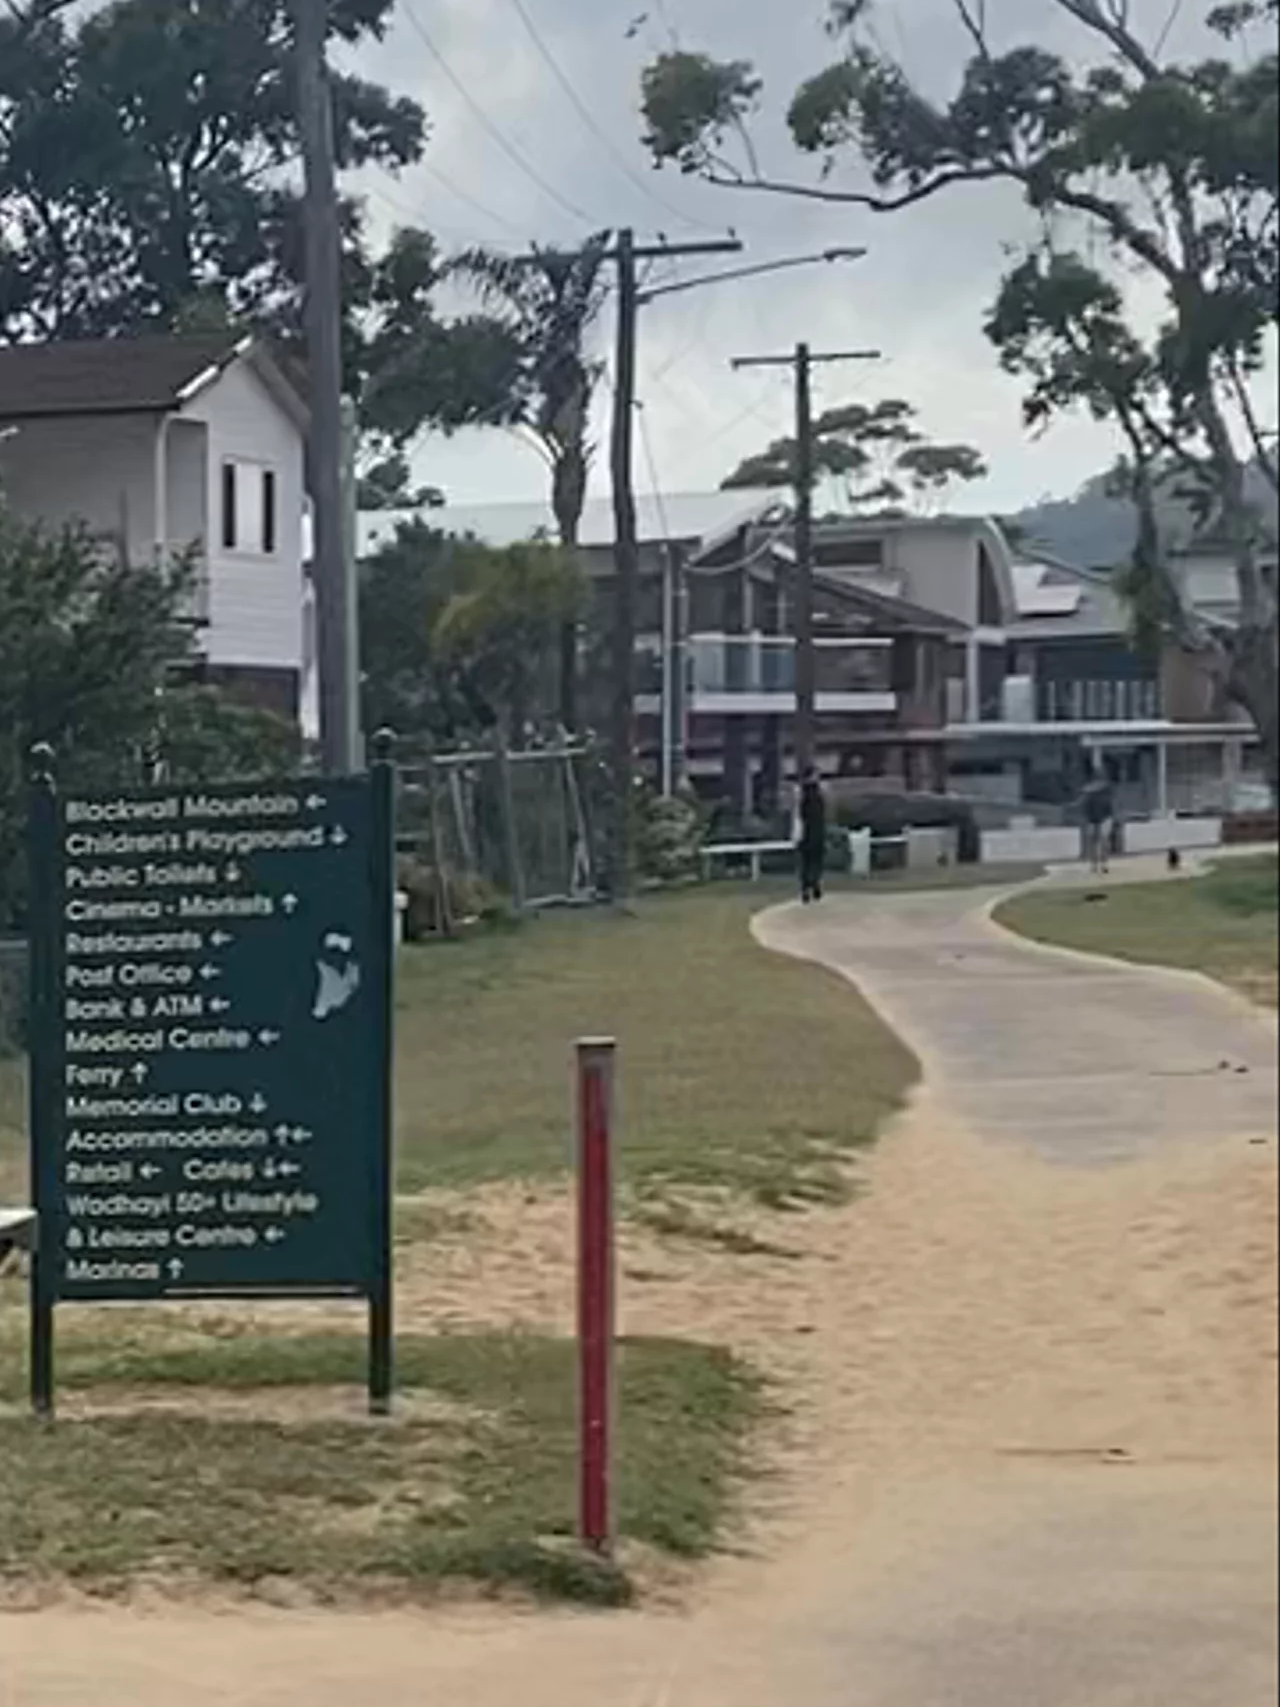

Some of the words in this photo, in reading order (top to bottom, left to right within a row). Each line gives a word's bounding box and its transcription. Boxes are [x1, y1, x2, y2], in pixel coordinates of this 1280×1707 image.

[183, 795, 299, 817] Mountain
[65, 832, 181, 855] Children's
[186, 826, 324, 853] Playground
[65, 866, 139, 888] Public
[144, 863, 217, 883] Toilets
[65, 901, 160, 921] Cinema
[179, 895, 274, 916] Markets
[65, 932, 203, 953] Restaurants
[65, 965, 114, 987] Post
[118, 964, 193, 984] Office
[65, 997, 125, 1019] Bank
[130, 997, 146, 1017] &
[151, 995, 203, 1016] ATM
[65, 1029, 163, 1052] Medical
[168, 1028, 251, 1048] Centre
[65, 1064, 124, 1087] Ferry
[65, 1096, 179, 1117] Memorial
[183, 1093, 242, 1115] Club
[65, 1126, 269, 1151] Accommodation
[65, 1162, 133, 1183] Retail
[221, 1192, 318, 1215] Lifestyle
[66, 1227, 82, 1247] &
[89, 1225, 171, 1247] Leisure
[175, 1224, 257, 1246] Centre
